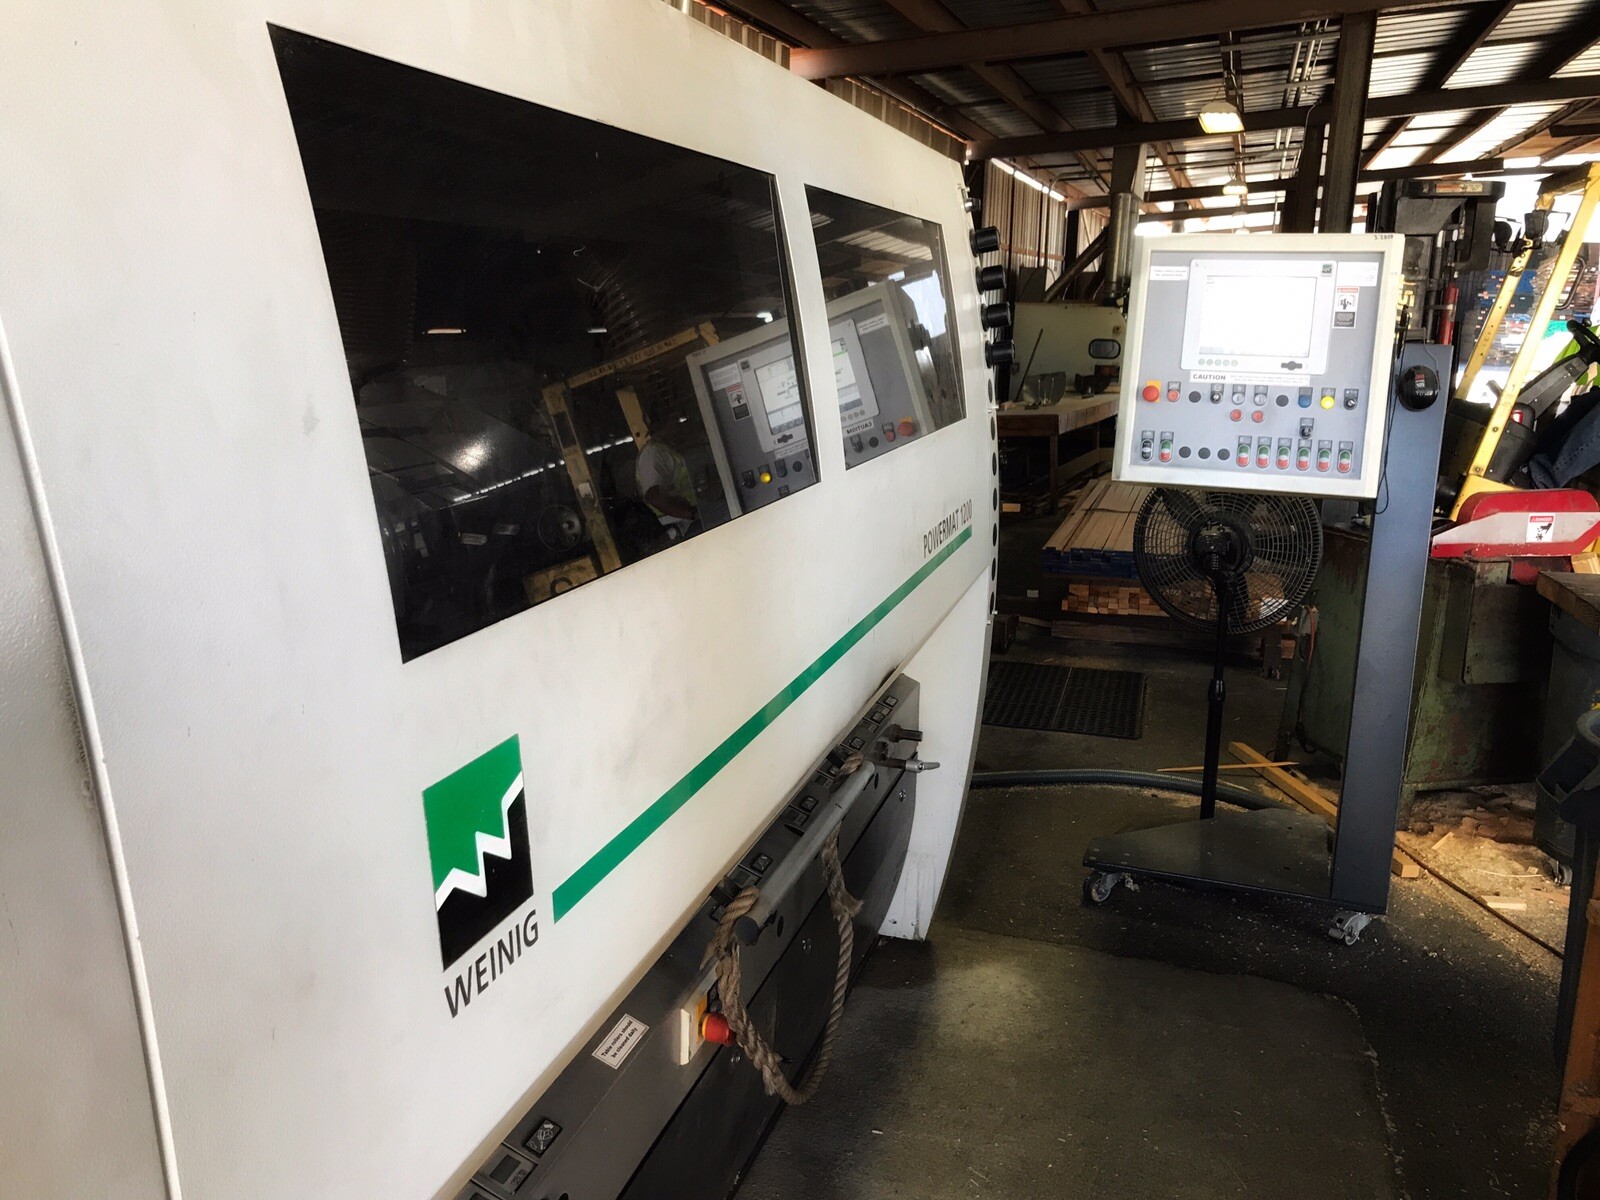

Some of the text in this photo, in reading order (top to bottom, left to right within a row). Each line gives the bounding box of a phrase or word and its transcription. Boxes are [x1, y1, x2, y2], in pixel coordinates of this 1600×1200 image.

[1192, 373, 1226, 381] CAUTION
[923, 498, 973, 559] POWERMAT 1200
[444, 909, 539, 1019] WEINIG
[601, 1019, 634, 1057] Table rollers should
[616, 1036, 630, 1053] cleaned
[628, 1027, 639, 1038] daily
